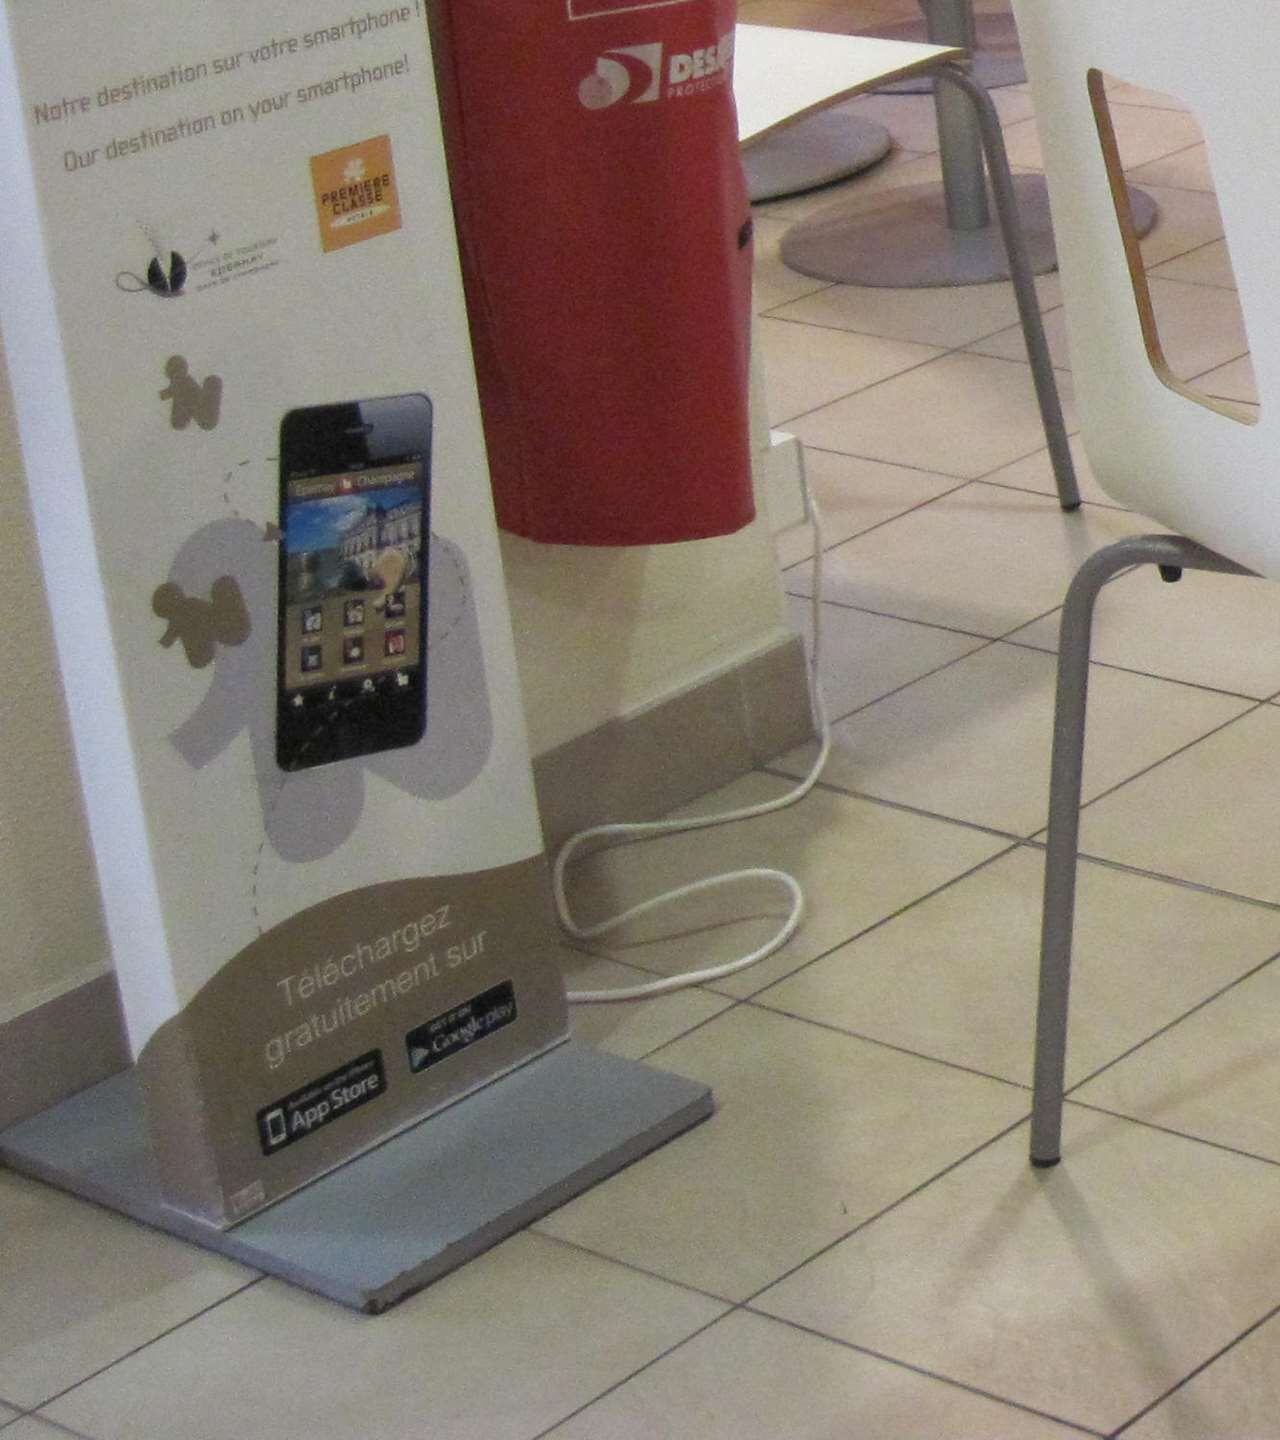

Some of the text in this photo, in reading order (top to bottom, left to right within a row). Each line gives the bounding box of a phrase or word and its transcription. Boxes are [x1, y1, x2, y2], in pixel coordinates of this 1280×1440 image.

[33, 96, 91, 125] Notre
[95, 62, 208, 109] destination
[212, 54, 244, 77] sur
[248, 37, 299, 65] votre
[303, 7, 412, 50] smartphone
[63, 53, 411, 173] Our destination on your smartphone!
[333, 192, 383, 216] CLASSE
[263, 929, 489, 1071] gratuitement sur
[276, 903, 452, 1009] Téléchargez
[291, 1101, 331, 1134] App
[332, 1072, 380, 1110] Store
